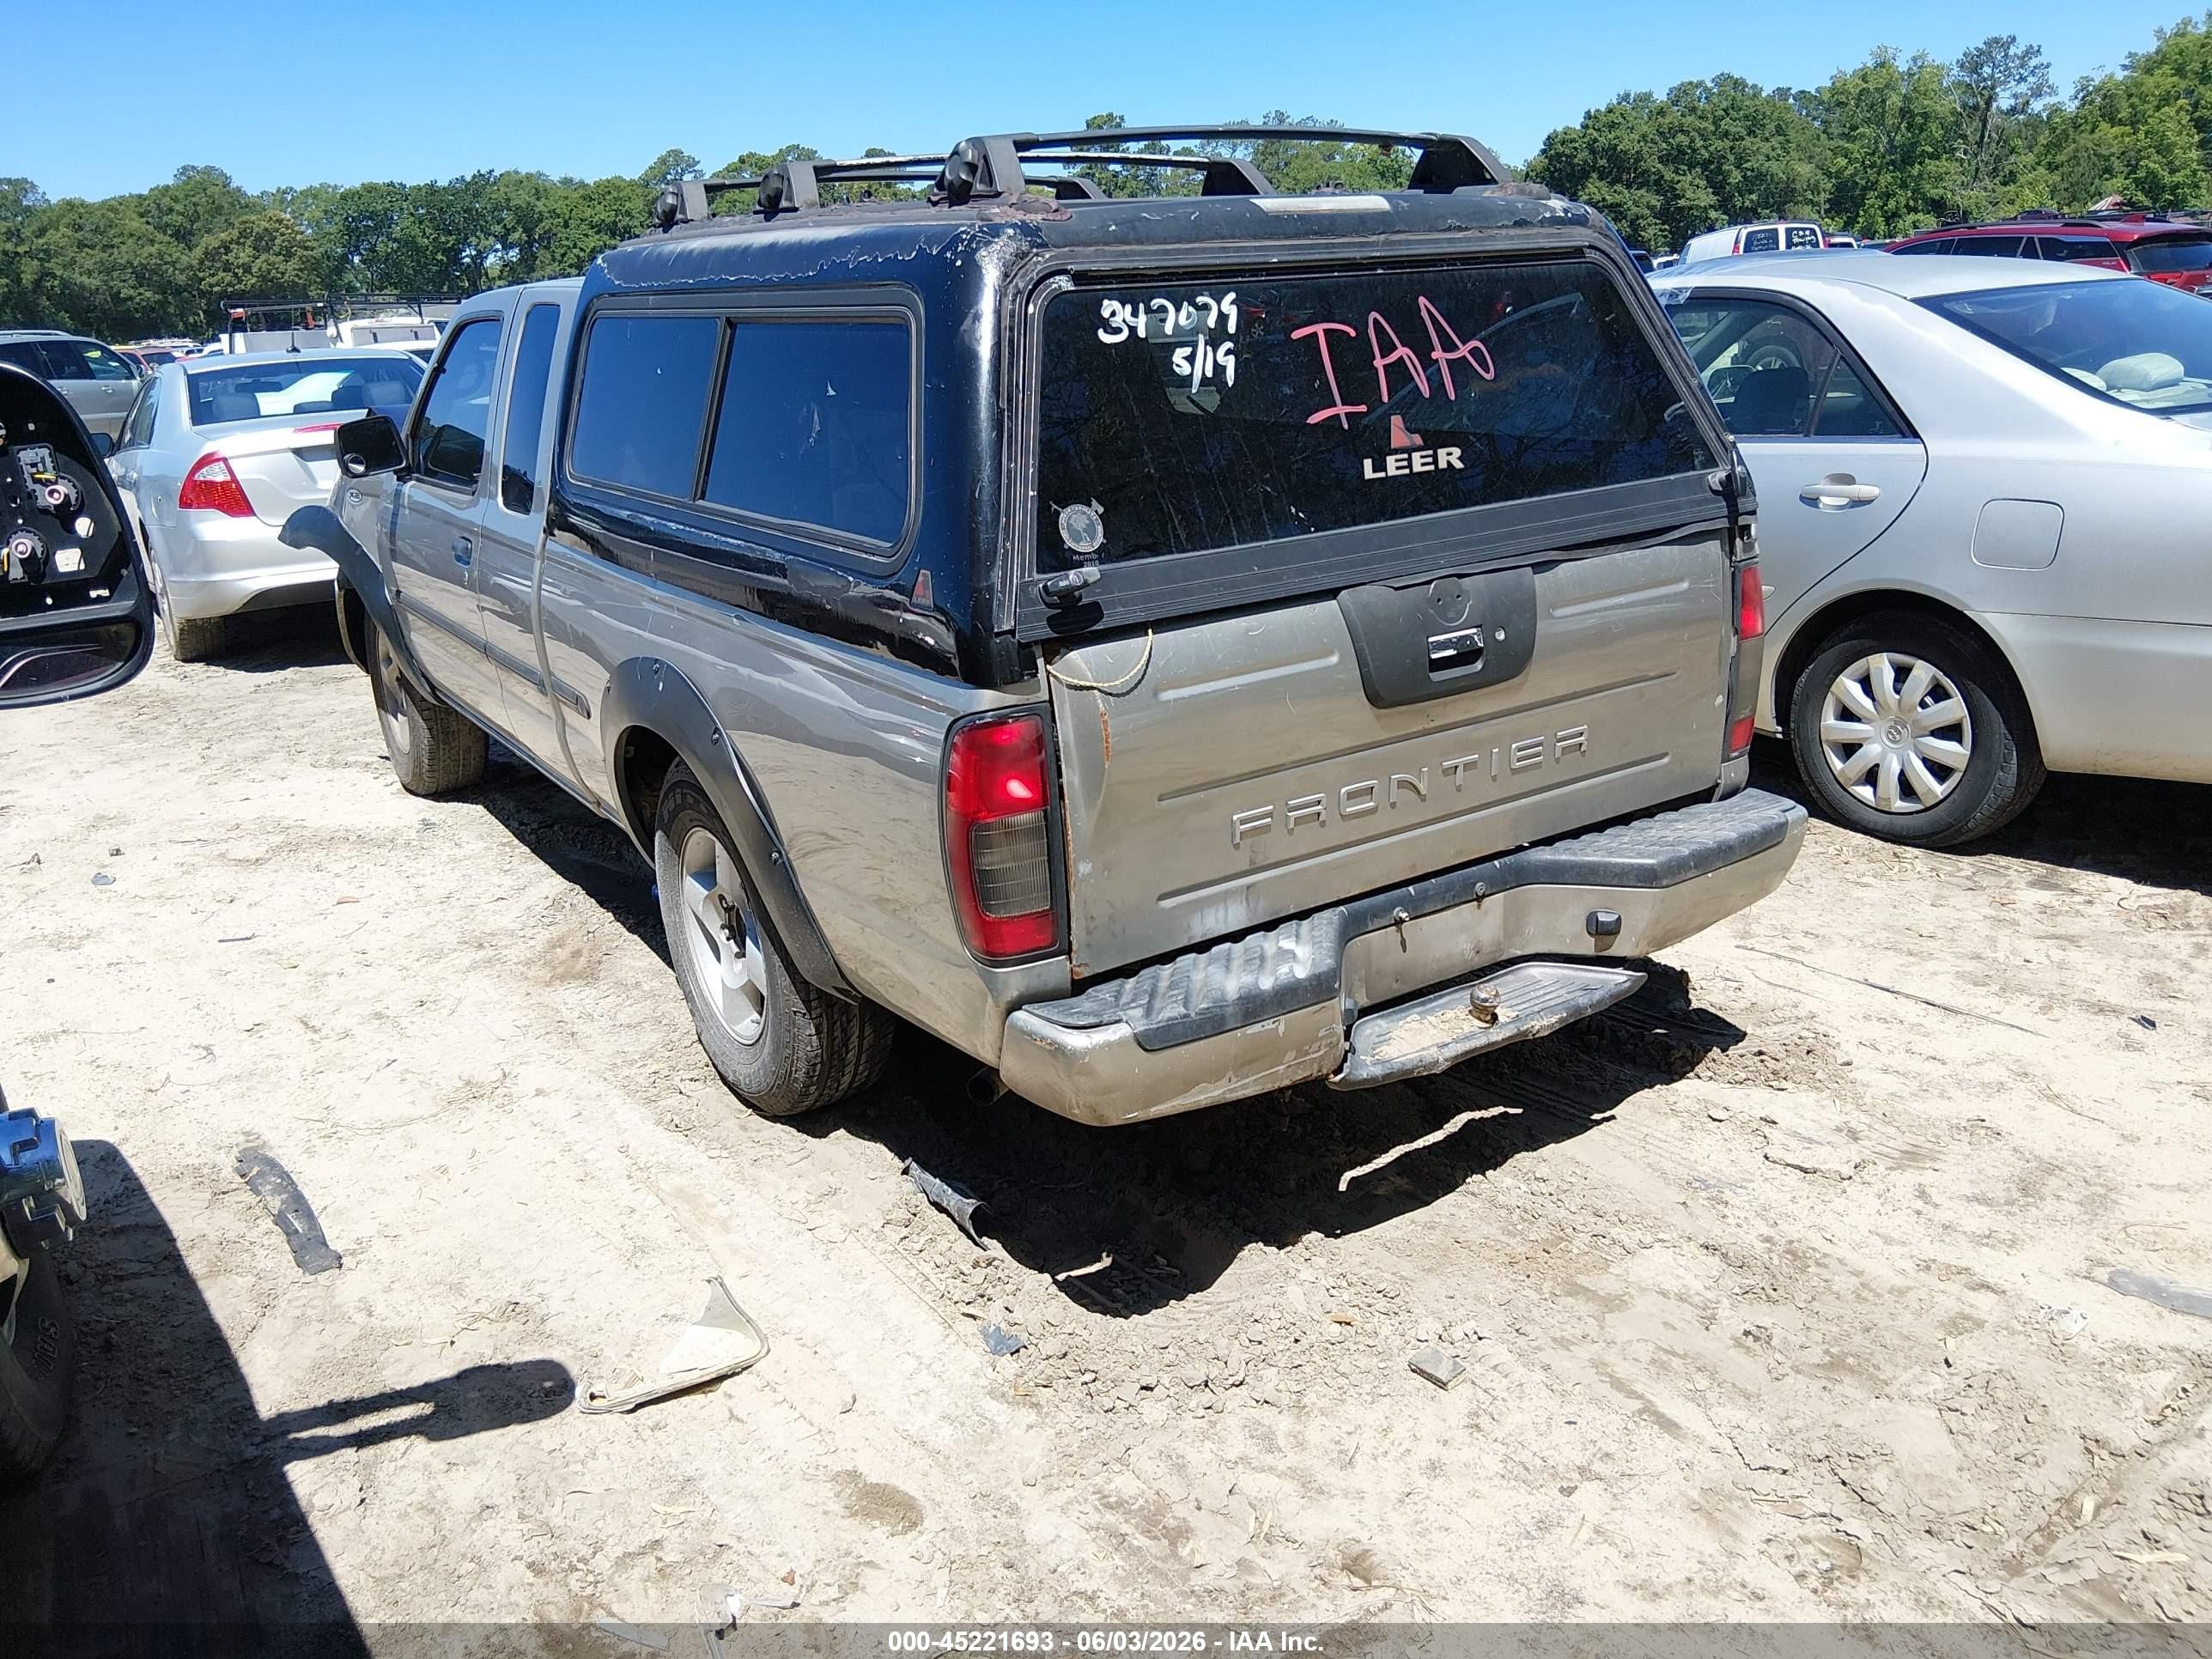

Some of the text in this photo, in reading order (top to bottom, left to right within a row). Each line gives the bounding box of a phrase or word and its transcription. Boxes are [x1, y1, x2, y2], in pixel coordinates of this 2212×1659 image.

[1097, 291, 1237, 343] 347079
[1172, 341, 1236, 393] 5/19
[1291, 295, 1495, 430] IAA
[1363, 447, 1465, 480] LEER
[1073, 552, 1105, 562] Membr
[1231, 725, 1588, 845] FRONTIER
